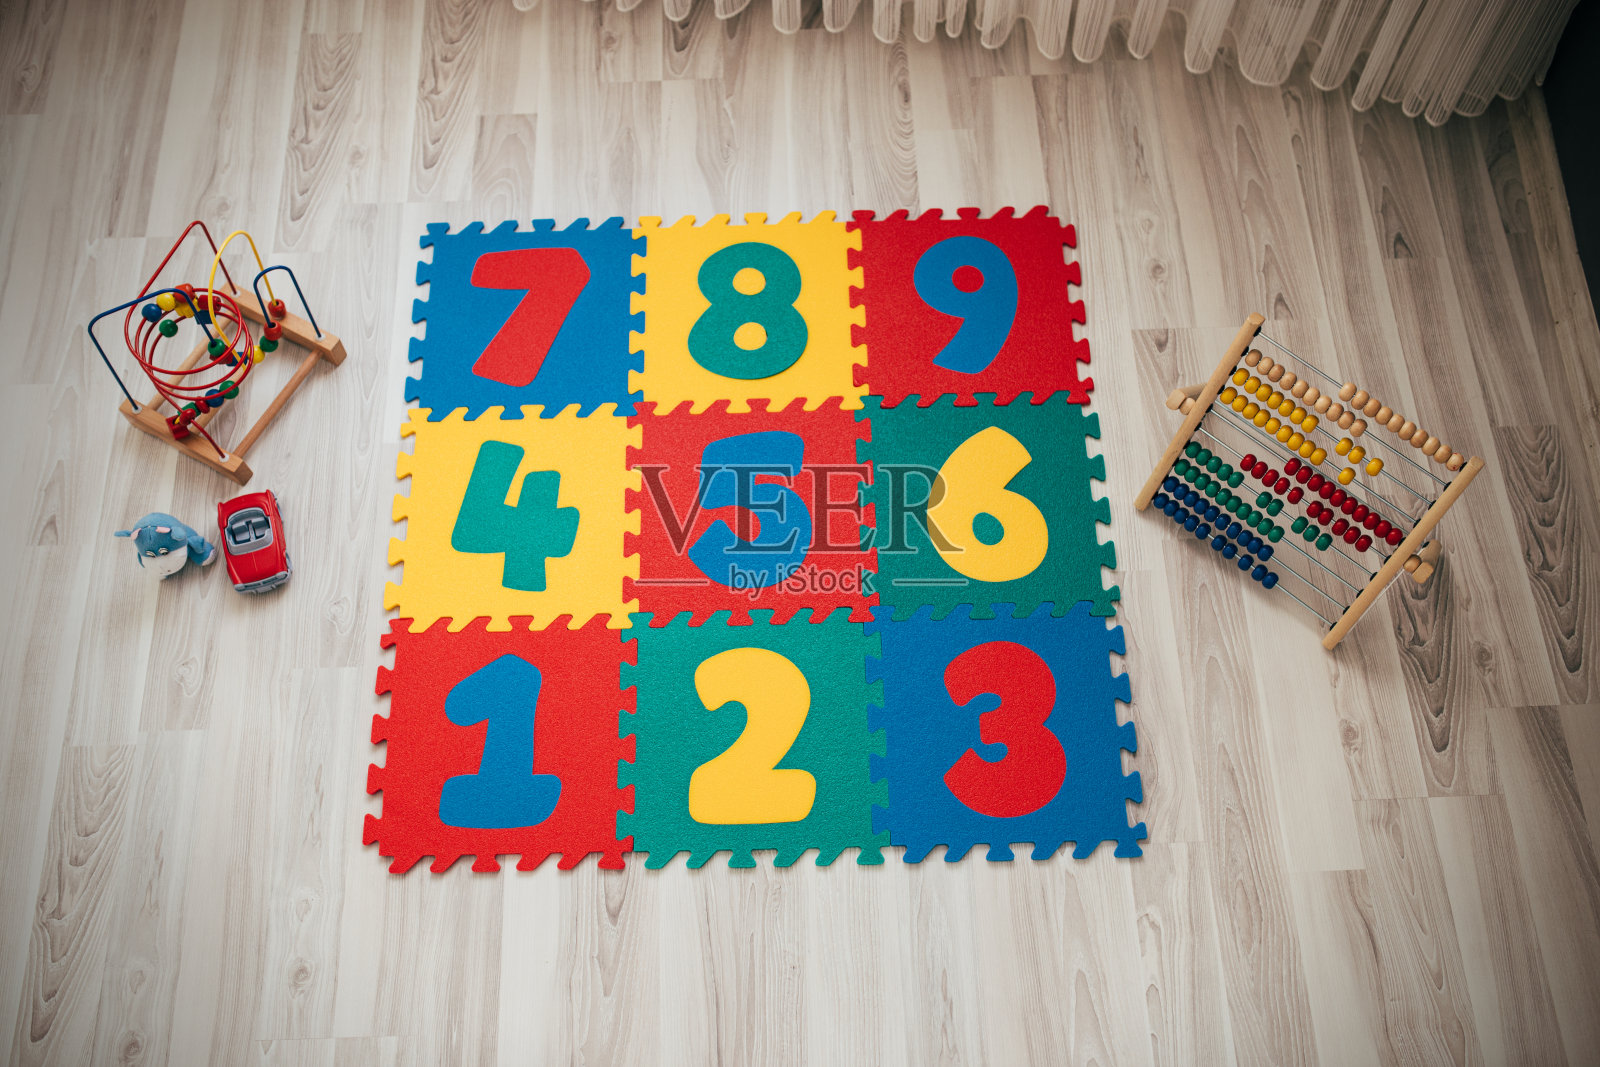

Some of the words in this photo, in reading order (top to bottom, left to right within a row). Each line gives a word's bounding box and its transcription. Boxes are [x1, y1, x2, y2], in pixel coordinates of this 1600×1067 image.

[471, 248, 590, 387] 7
[688, 242, 808, 379] 8
[914, 236, 1017, 373] 9
[452, 441, 579, 591] 4
[688, 431, 812, 588] 5
[927, 427, 1048, 582] 6
[439, 654, 561, 828] 1
[689, 648, 816, 824] 2
[944, 641, 1066, 817] 3
